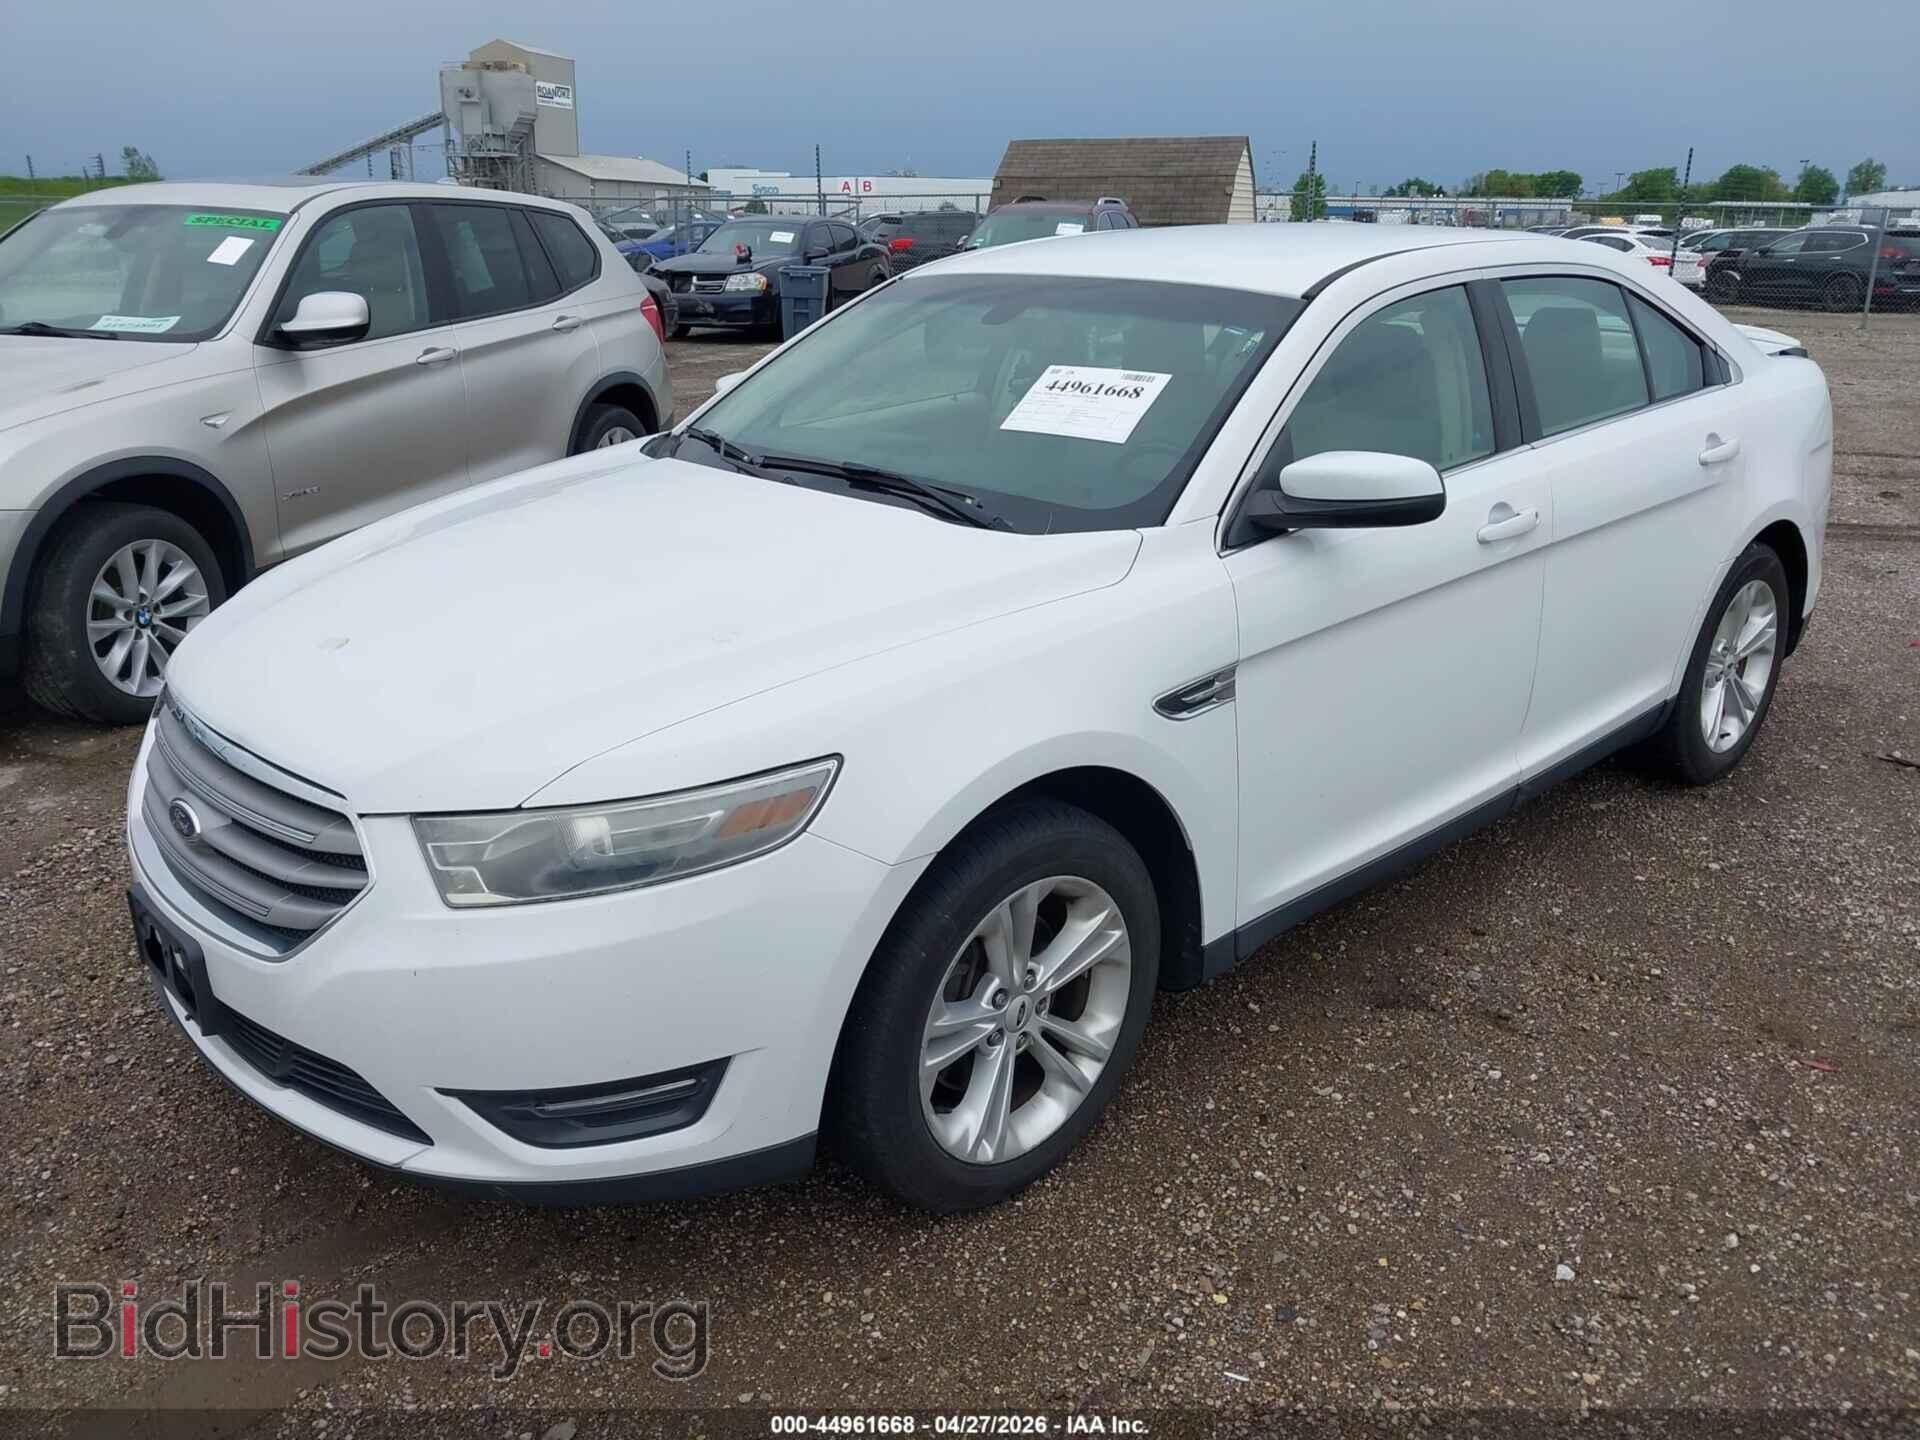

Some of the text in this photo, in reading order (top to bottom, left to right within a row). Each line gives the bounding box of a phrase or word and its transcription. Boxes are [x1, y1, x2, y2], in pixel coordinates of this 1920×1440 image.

[752, 184, 779, 194] Sysco
[842, 181, 872, 192] A B
[191, 216, 272, 228] SPECIAL
[1046, 379, 1144, 400] 44961668
